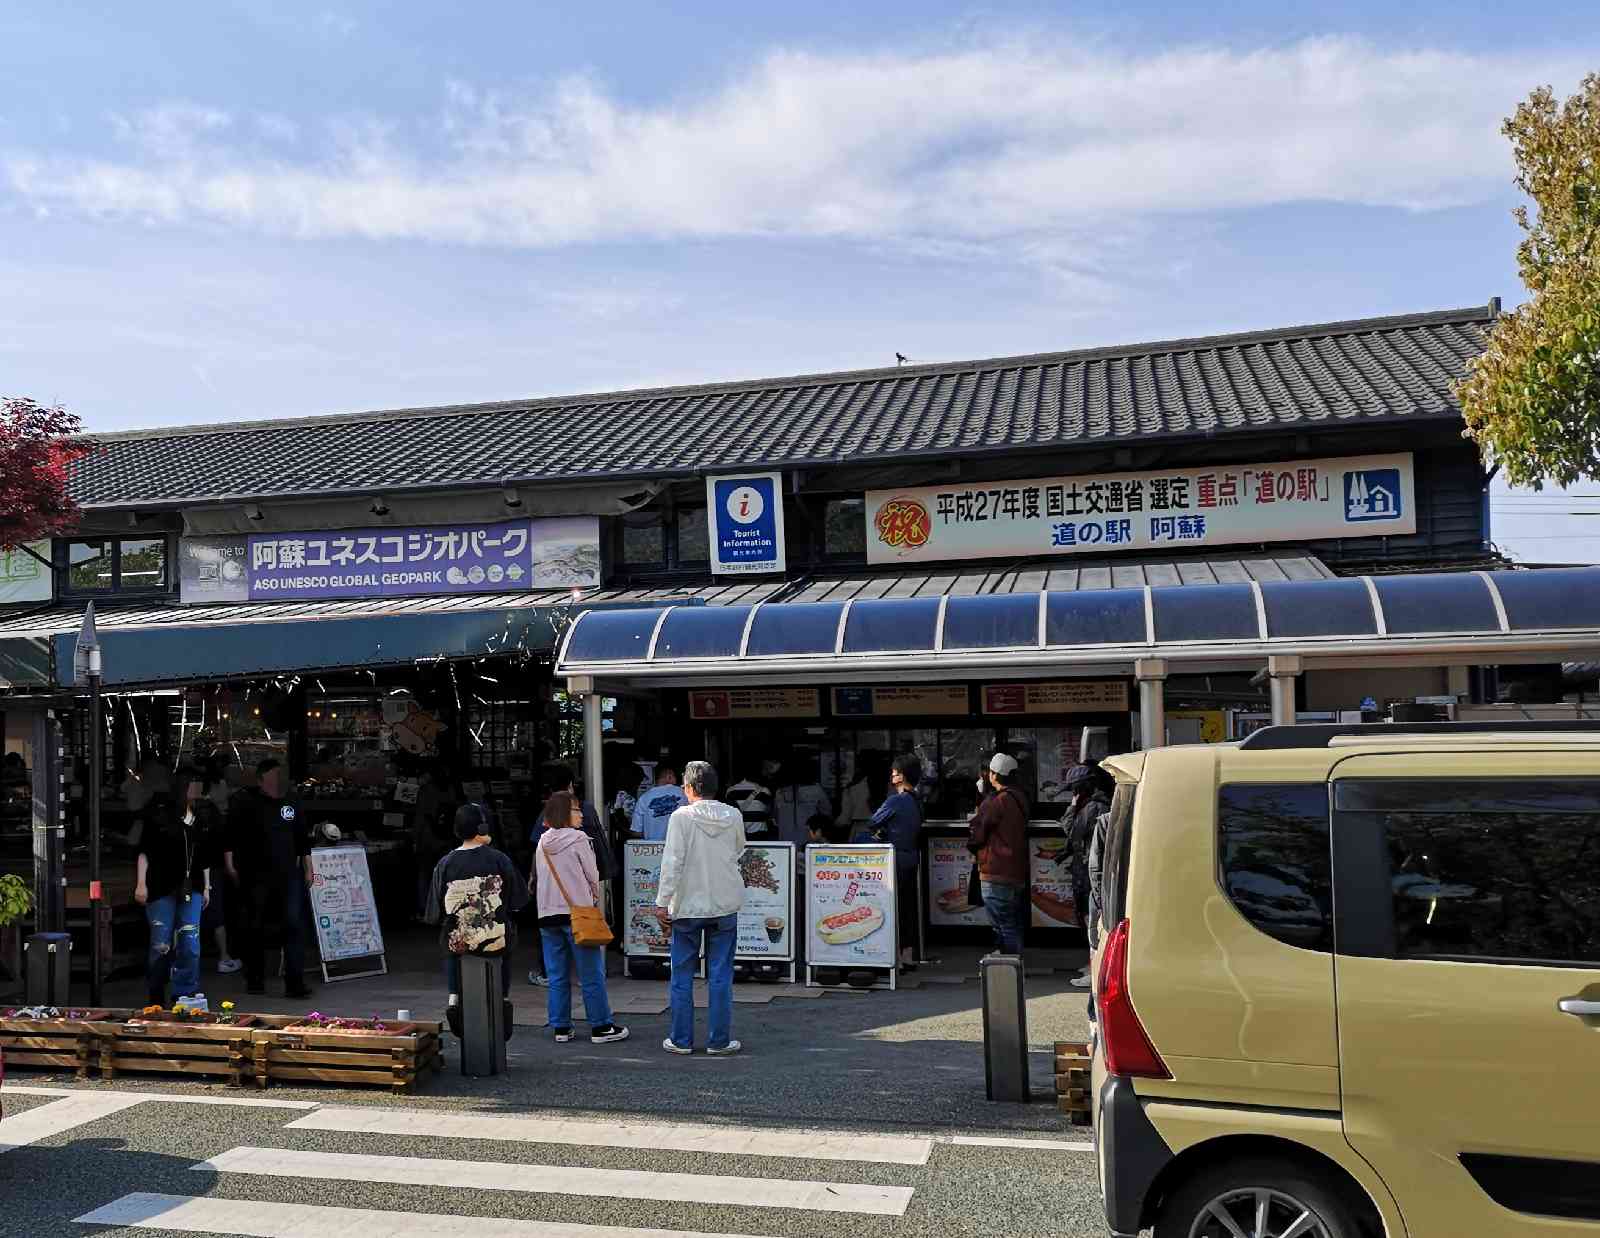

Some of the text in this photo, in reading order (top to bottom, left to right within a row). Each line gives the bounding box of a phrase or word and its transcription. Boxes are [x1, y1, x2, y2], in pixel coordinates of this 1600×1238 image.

[936, 486, 1041, 524] 平成27年度
[1046, 480, 1144, 518] 国土交通省
[1150, 476, 1190, 511] 選定
[734, 529, 760, 538] Tourist
[879, 501, 930, 546] 祝
[1052, 514, 1208, 546] 道の駅 阿蘇
[252, 528, 528, 571] 阿蘇ユネスコジオパーク
[723, 539, 772, 548] Information
[254, 570, 442, 591] ASO UNESCO GLOBAL GEOPARK
